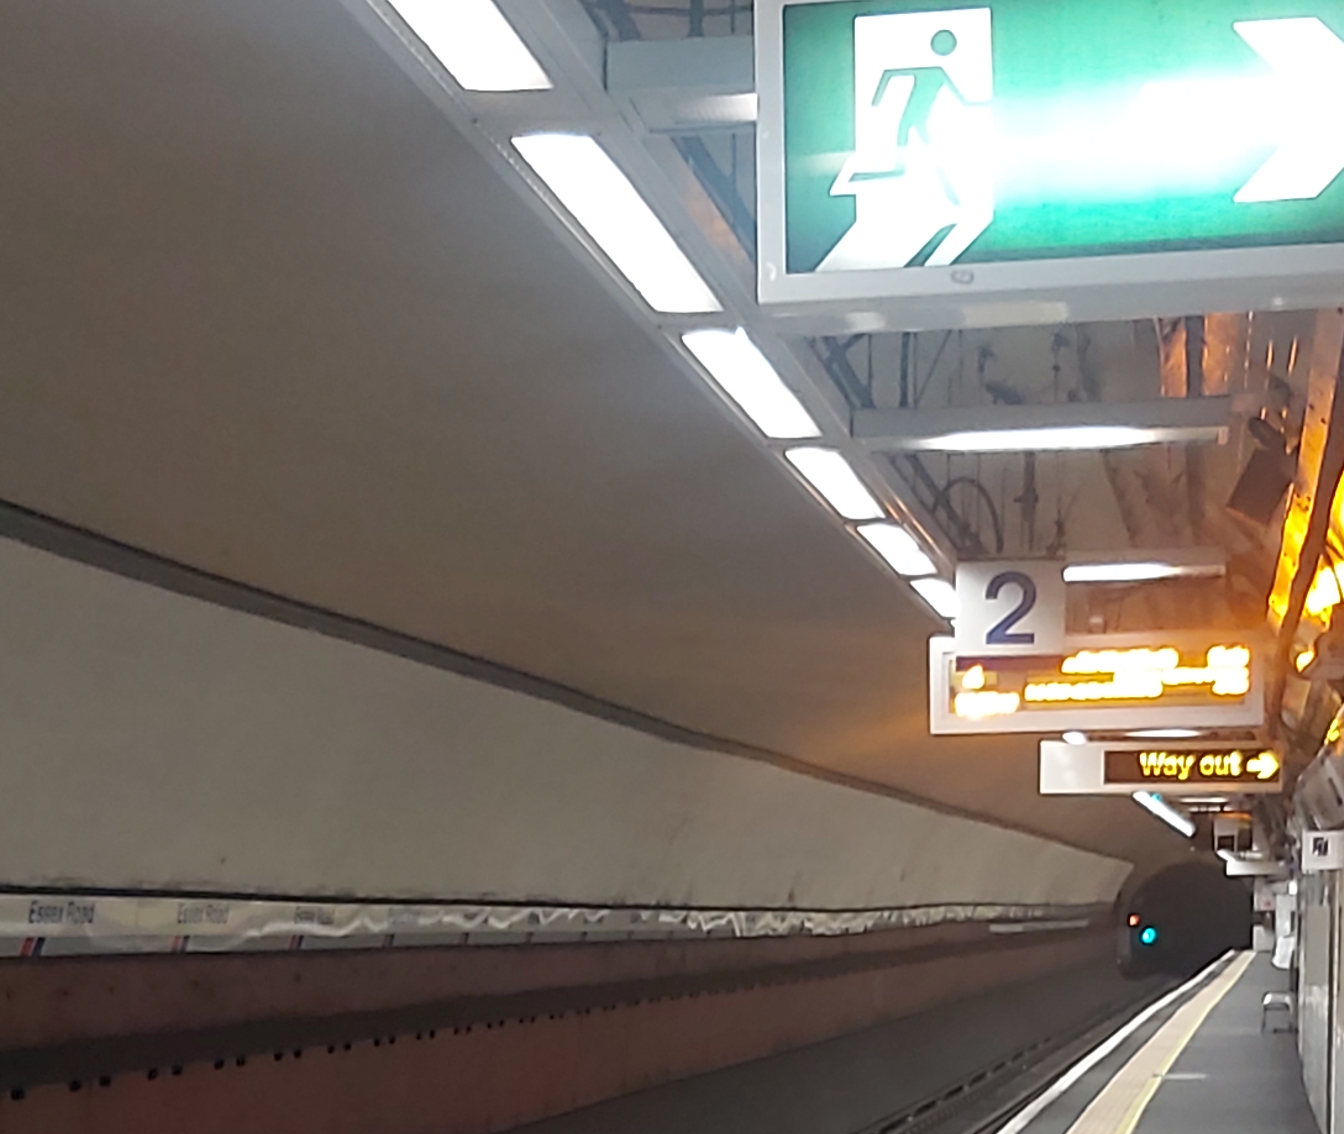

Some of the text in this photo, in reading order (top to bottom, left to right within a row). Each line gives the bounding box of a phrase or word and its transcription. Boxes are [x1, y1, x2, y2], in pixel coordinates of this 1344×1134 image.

[985, 571, 1036, 645] 2
[1140, 751, 1241, 780] Way out
